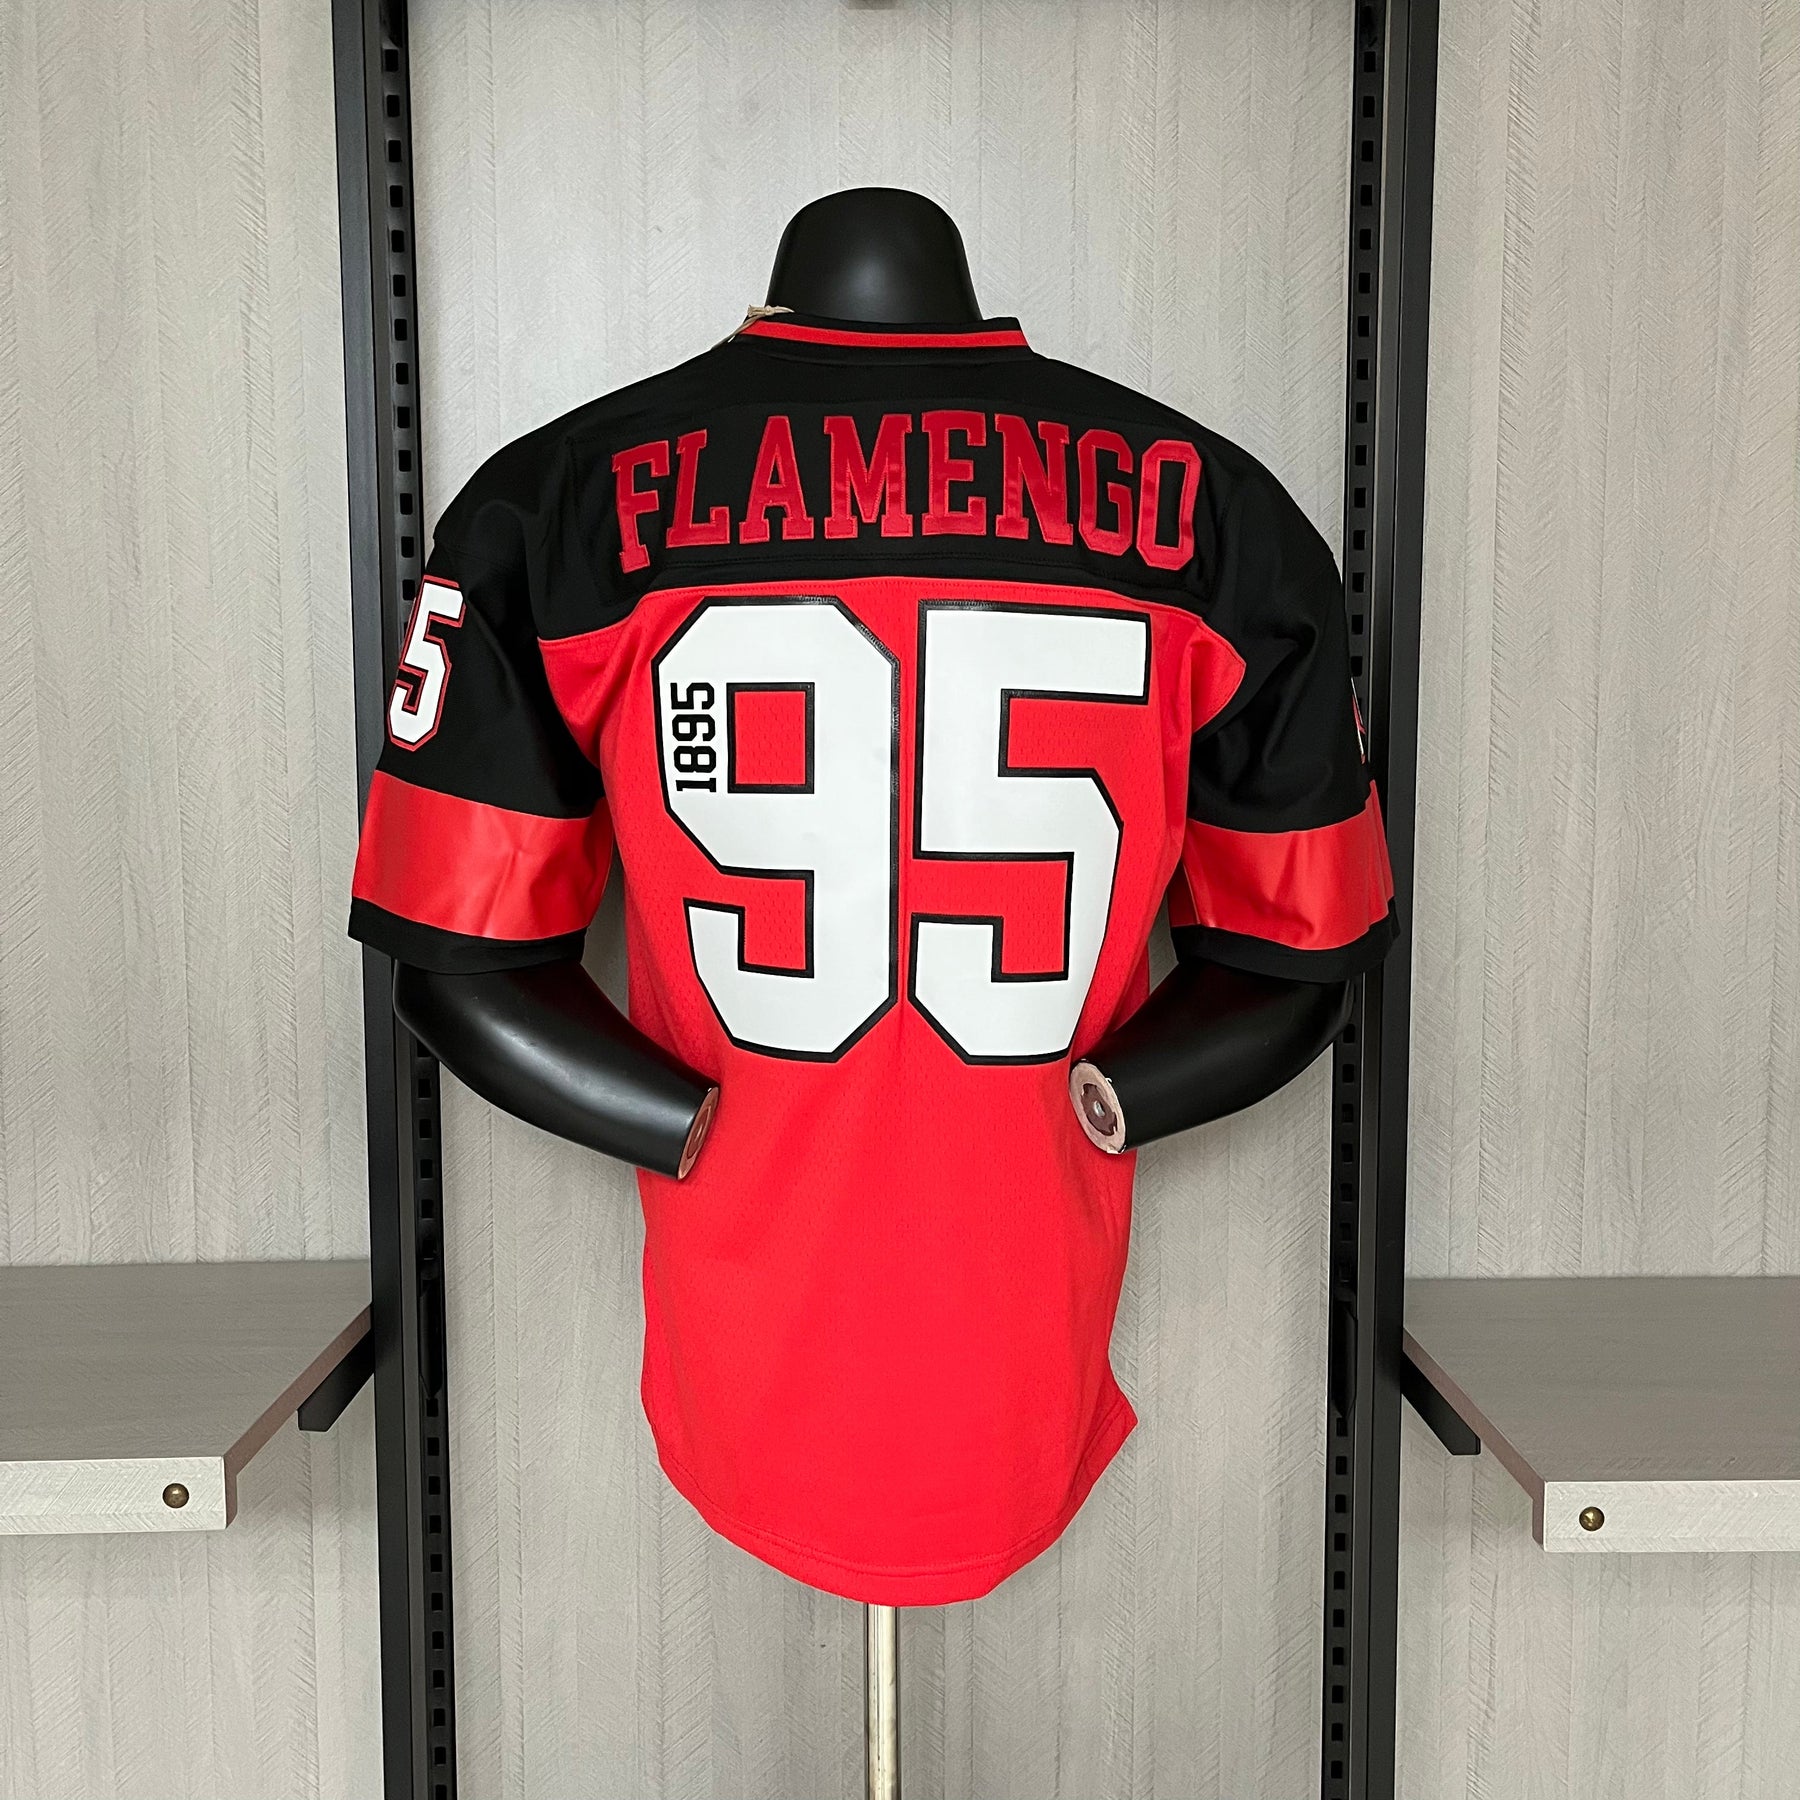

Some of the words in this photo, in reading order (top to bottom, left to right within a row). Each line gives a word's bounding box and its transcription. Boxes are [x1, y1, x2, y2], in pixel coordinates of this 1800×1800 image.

[611, 410, 1203, 574] FLAMENGO
[670, 682, 717, 793] 1895
[652, 595, 1151, 1066] 95
